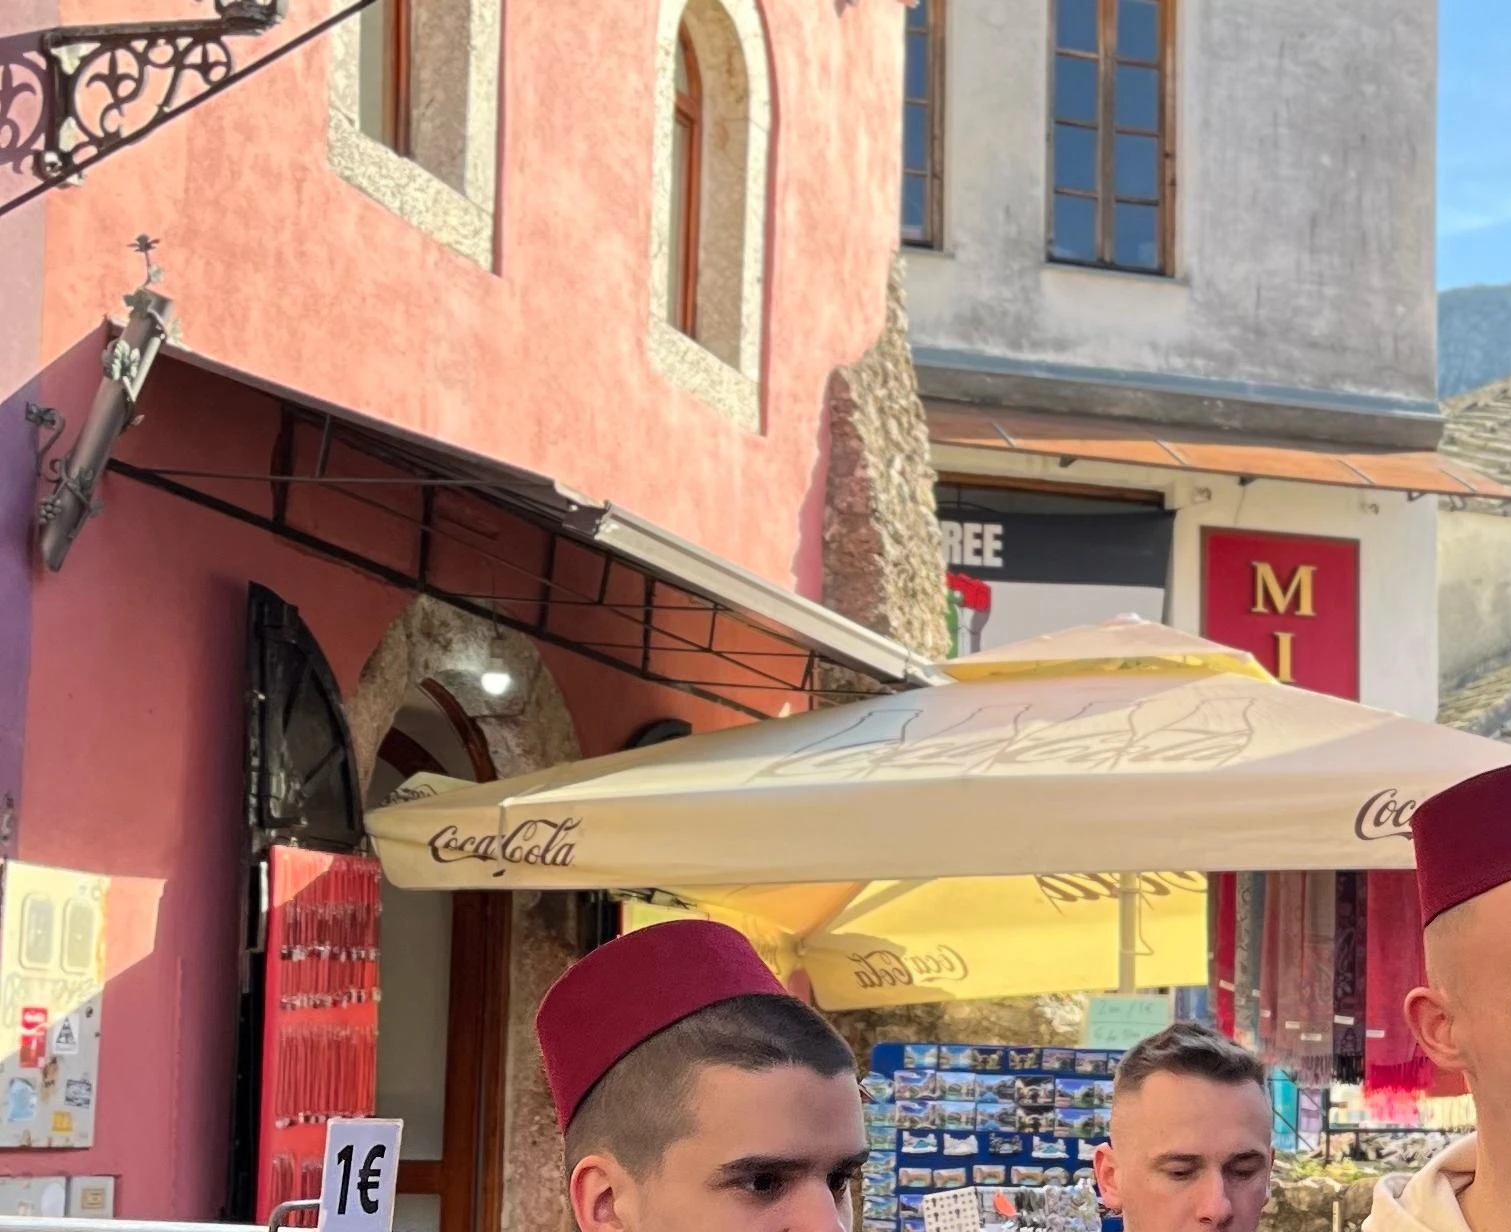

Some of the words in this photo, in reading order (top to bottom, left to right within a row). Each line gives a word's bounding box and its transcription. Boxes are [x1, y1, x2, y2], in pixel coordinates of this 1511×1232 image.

[941, 521, 1004, 568] REE
[1354, 788, 1413, 841] Coc
[337, 1144, 387, 1215] 1€
